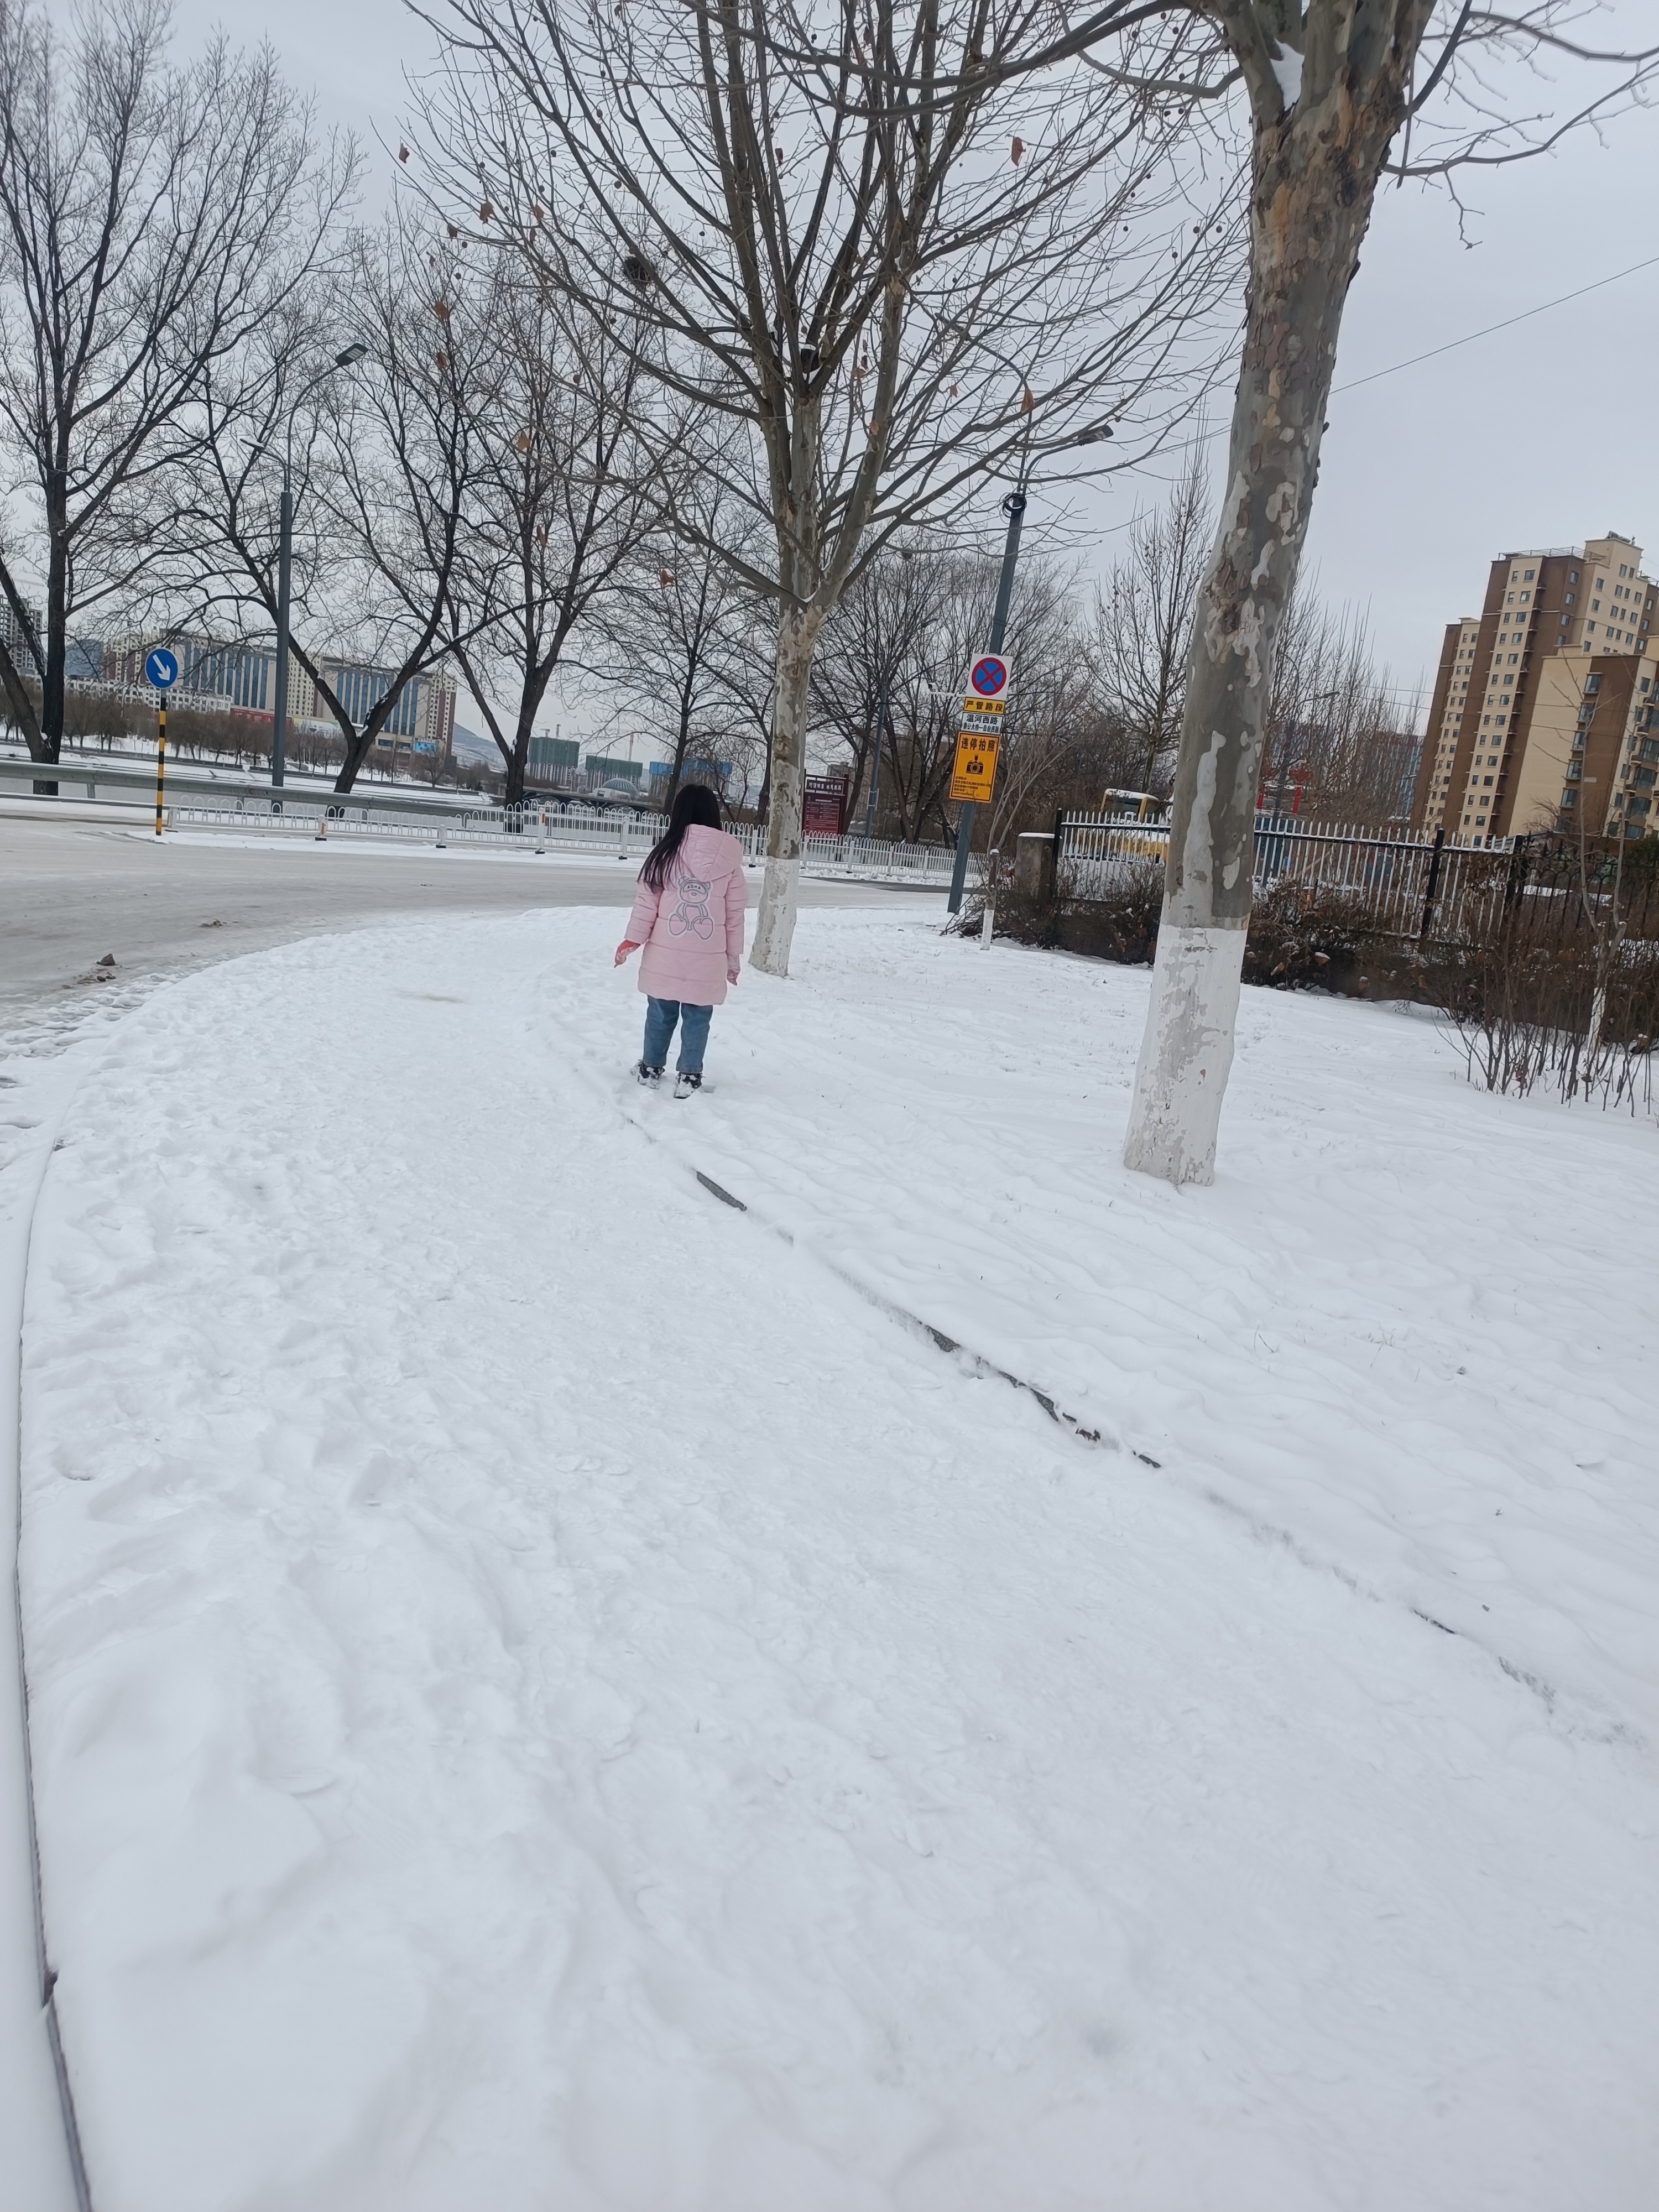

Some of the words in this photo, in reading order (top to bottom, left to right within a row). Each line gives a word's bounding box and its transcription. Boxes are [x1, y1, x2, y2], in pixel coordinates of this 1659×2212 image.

[966, 700, 1003, 712] 严管路段
[961, 737, 995, 752] 违停拍照
